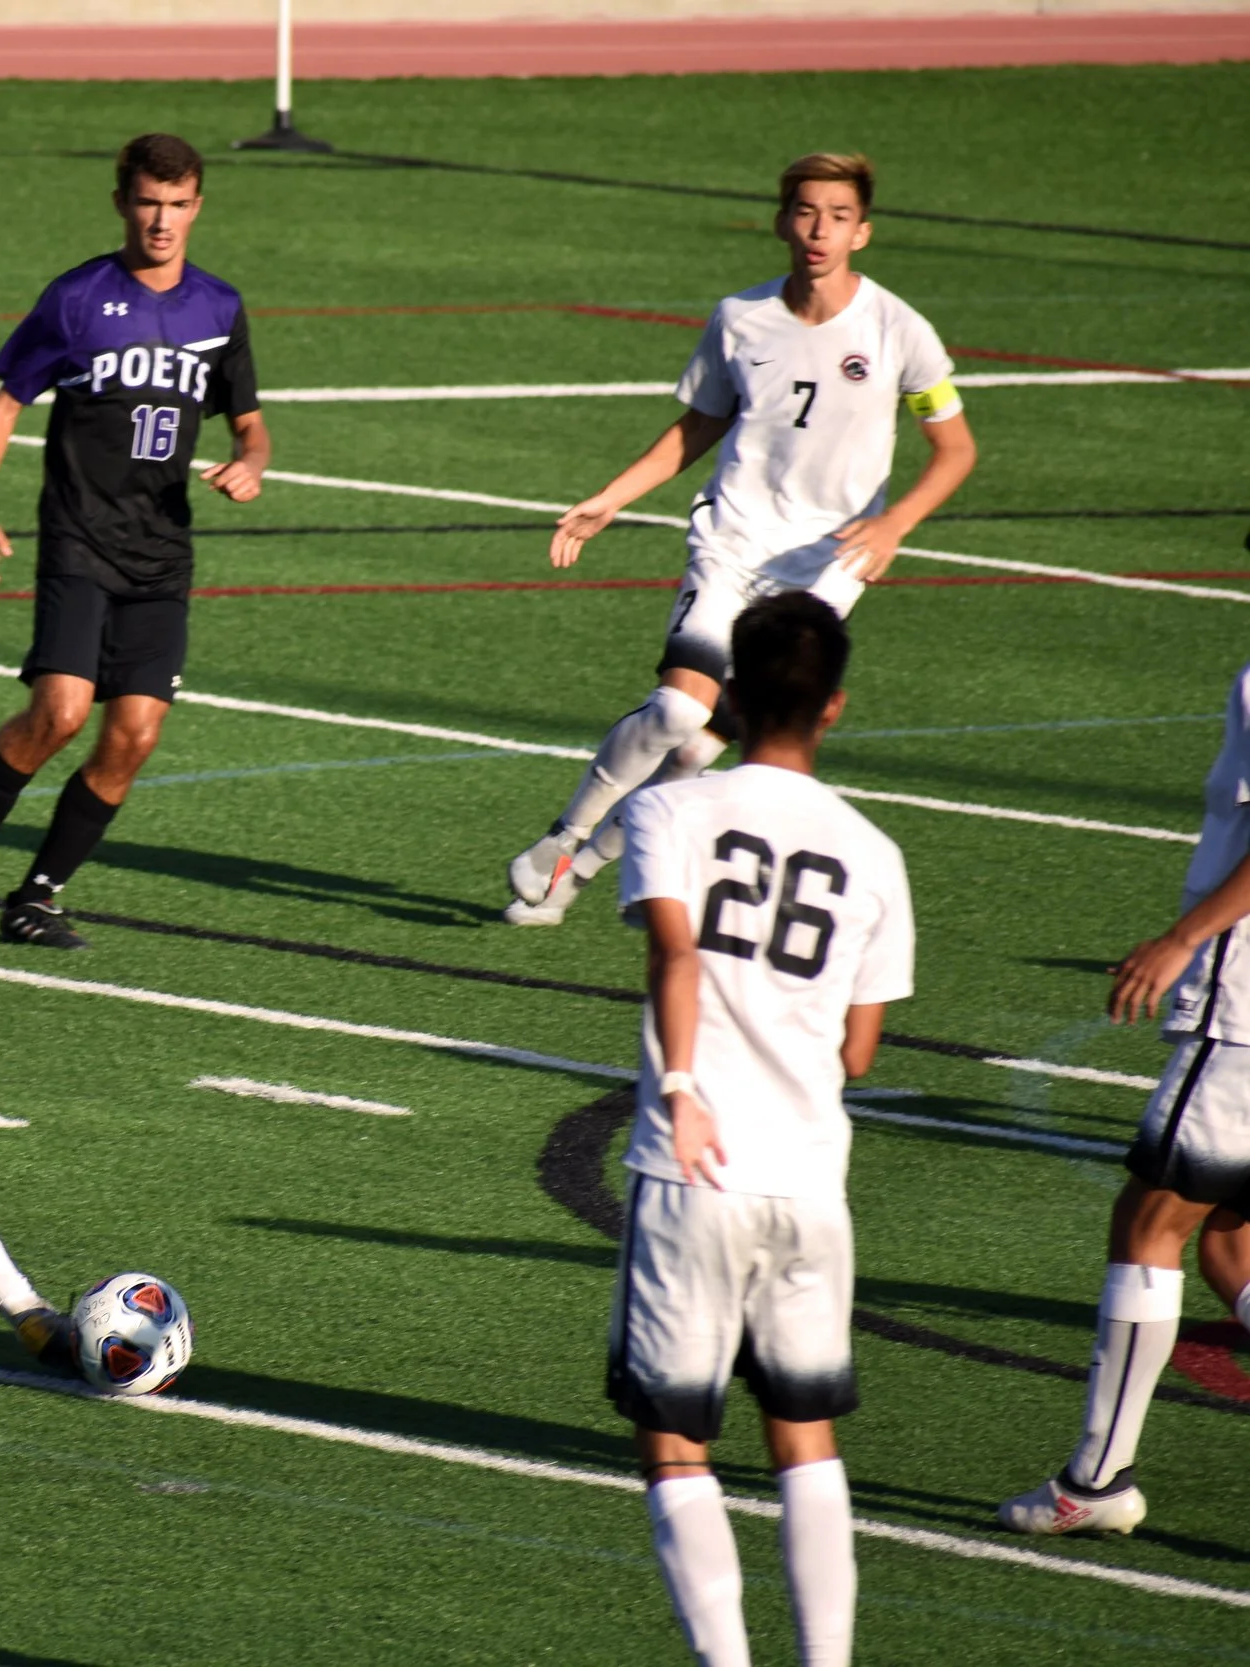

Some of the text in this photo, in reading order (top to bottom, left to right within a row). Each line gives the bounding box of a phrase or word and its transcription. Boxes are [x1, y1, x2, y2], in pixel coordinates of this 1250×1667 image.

[90, 346, 211, 403] POETS
[131, 404, 180, 461] 16
[792, 380, 817, 428] 7
[670, 590, 697, 634] 7
[697, 829, 848, 980] 26
